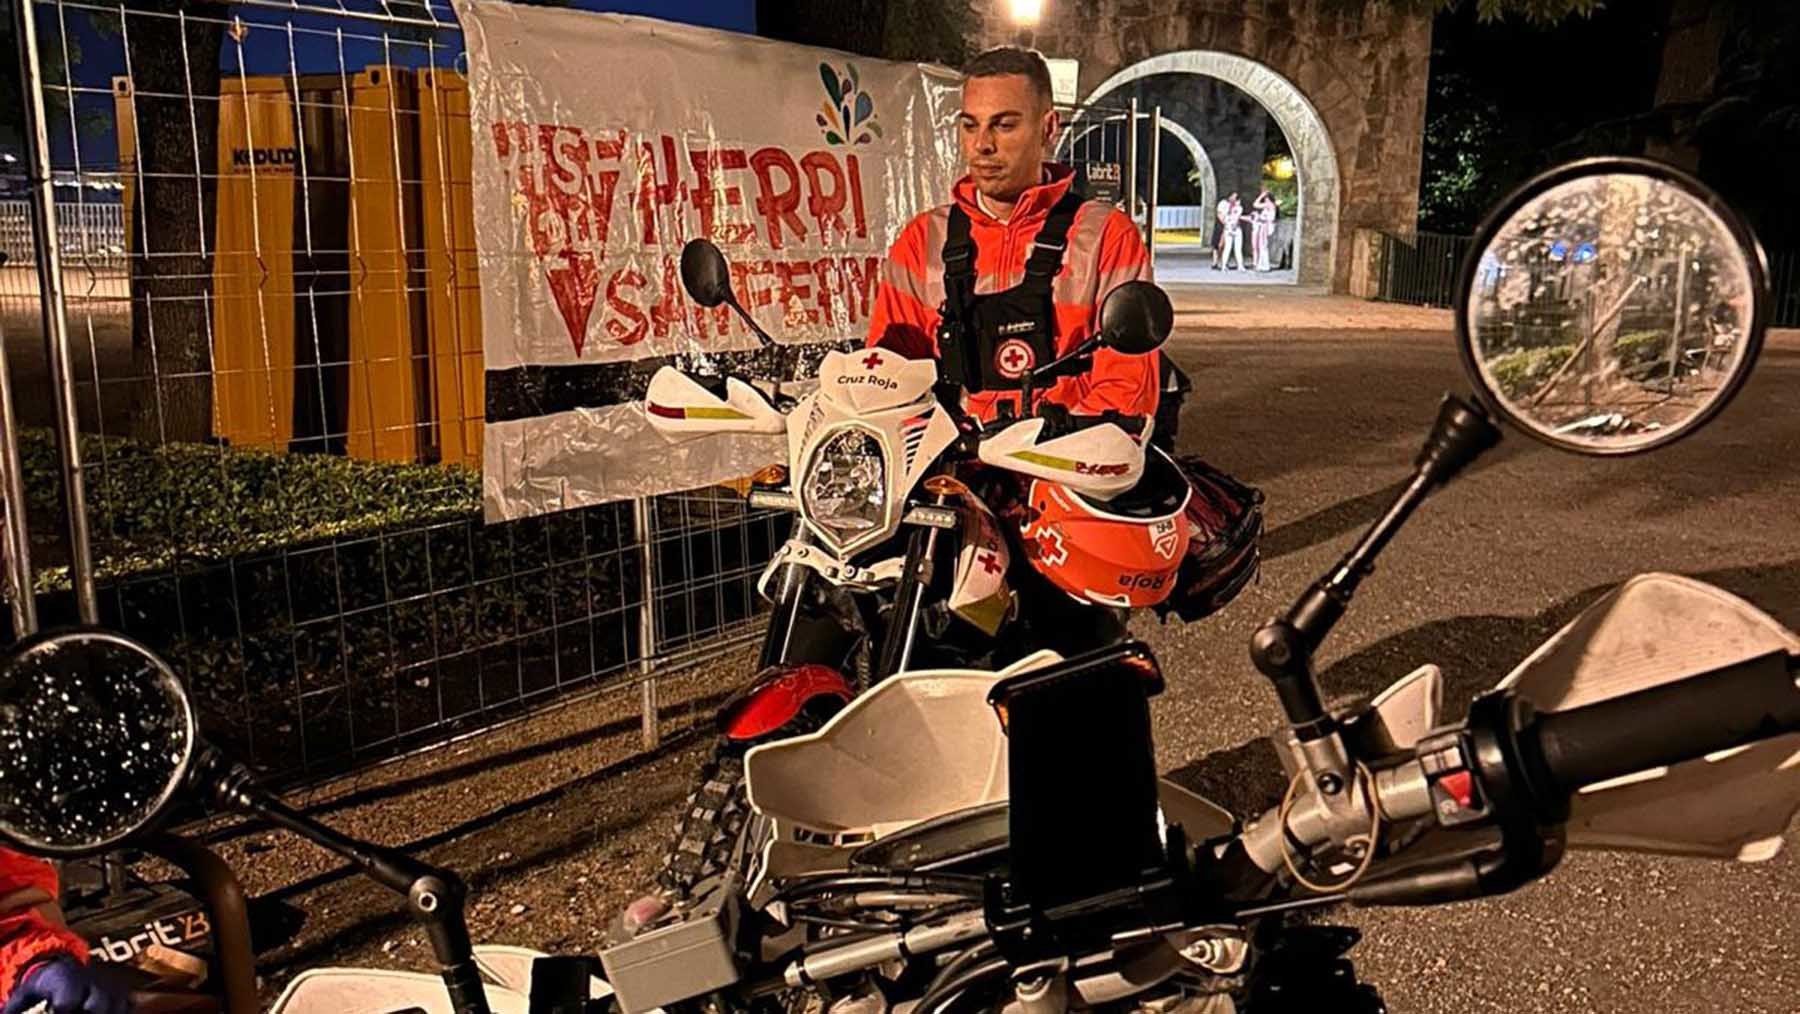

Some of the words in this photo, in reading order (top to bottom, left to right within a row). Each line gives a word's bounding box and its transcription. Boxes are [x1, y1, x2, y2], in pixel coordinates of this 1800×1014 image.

[629, 134, 867, 250] HERRI
[837, 375, 865, 385] Cruz
[867, 375, 898, 390] Roja
[1119, 572, 1168, 592] Roja
[88, 920, 181, 962] abrit
